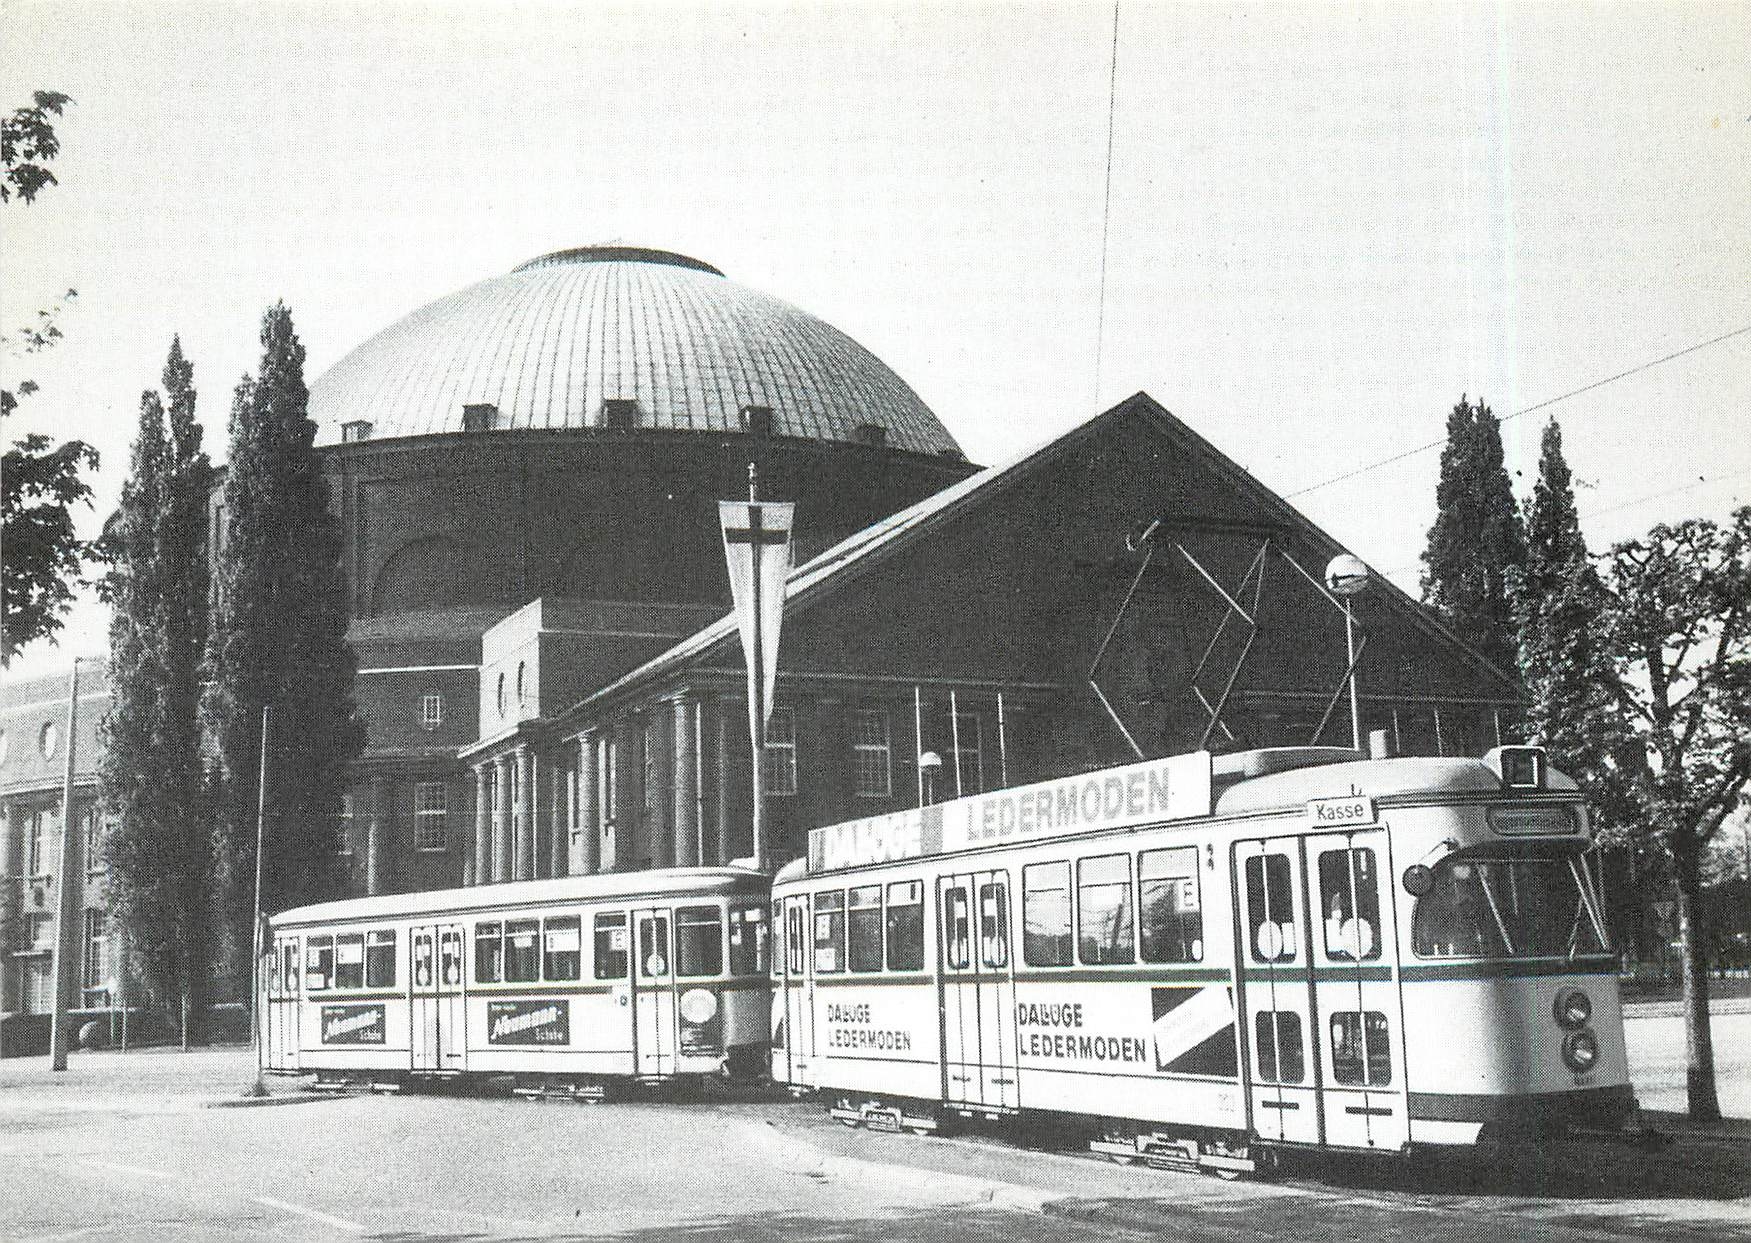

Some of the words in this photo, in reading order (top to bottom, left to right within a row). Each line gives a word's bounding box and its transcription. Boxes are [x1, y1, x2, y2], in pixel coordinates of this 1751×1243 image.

[967, 768, 1170, 840] LEDERMODEN
[1316, 804, 1364, 820] Kasse
[829, 1029, 911, 1050] LEDERMODEN
[1019, 1033, 1146, 1062] LEDERMODEN
